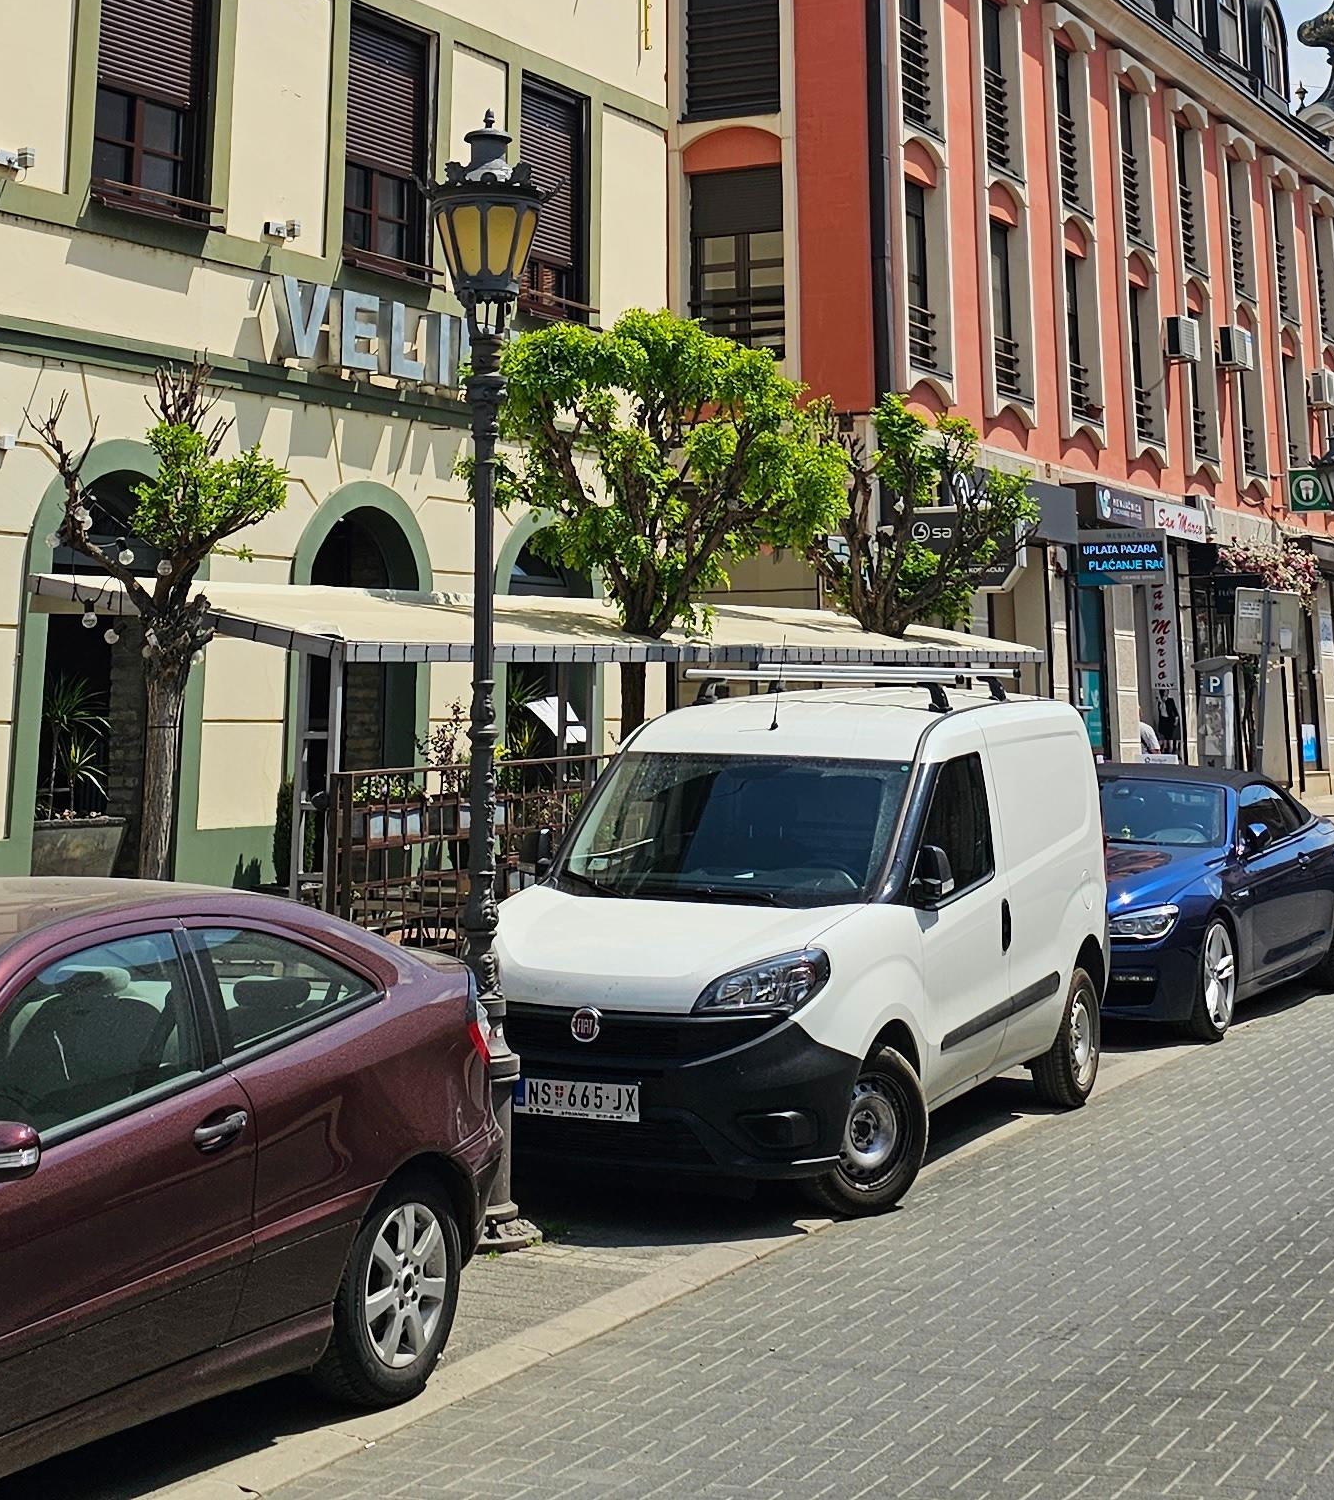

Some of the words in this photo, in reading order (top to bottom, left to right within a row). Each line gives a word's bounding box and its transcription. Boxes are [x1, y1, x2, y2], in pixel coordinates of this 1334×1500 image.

[1083, 544, 1119, 555] UPLATA
[1120, 543, 1157, 554] PAZARA
[1088, 558, 1143, 571] PLAĆANJE
[1209, 676, 1221, 693] P
[577, 1018, 593, 1034] FIAT
[529, 1081, 552, 1106] NS
